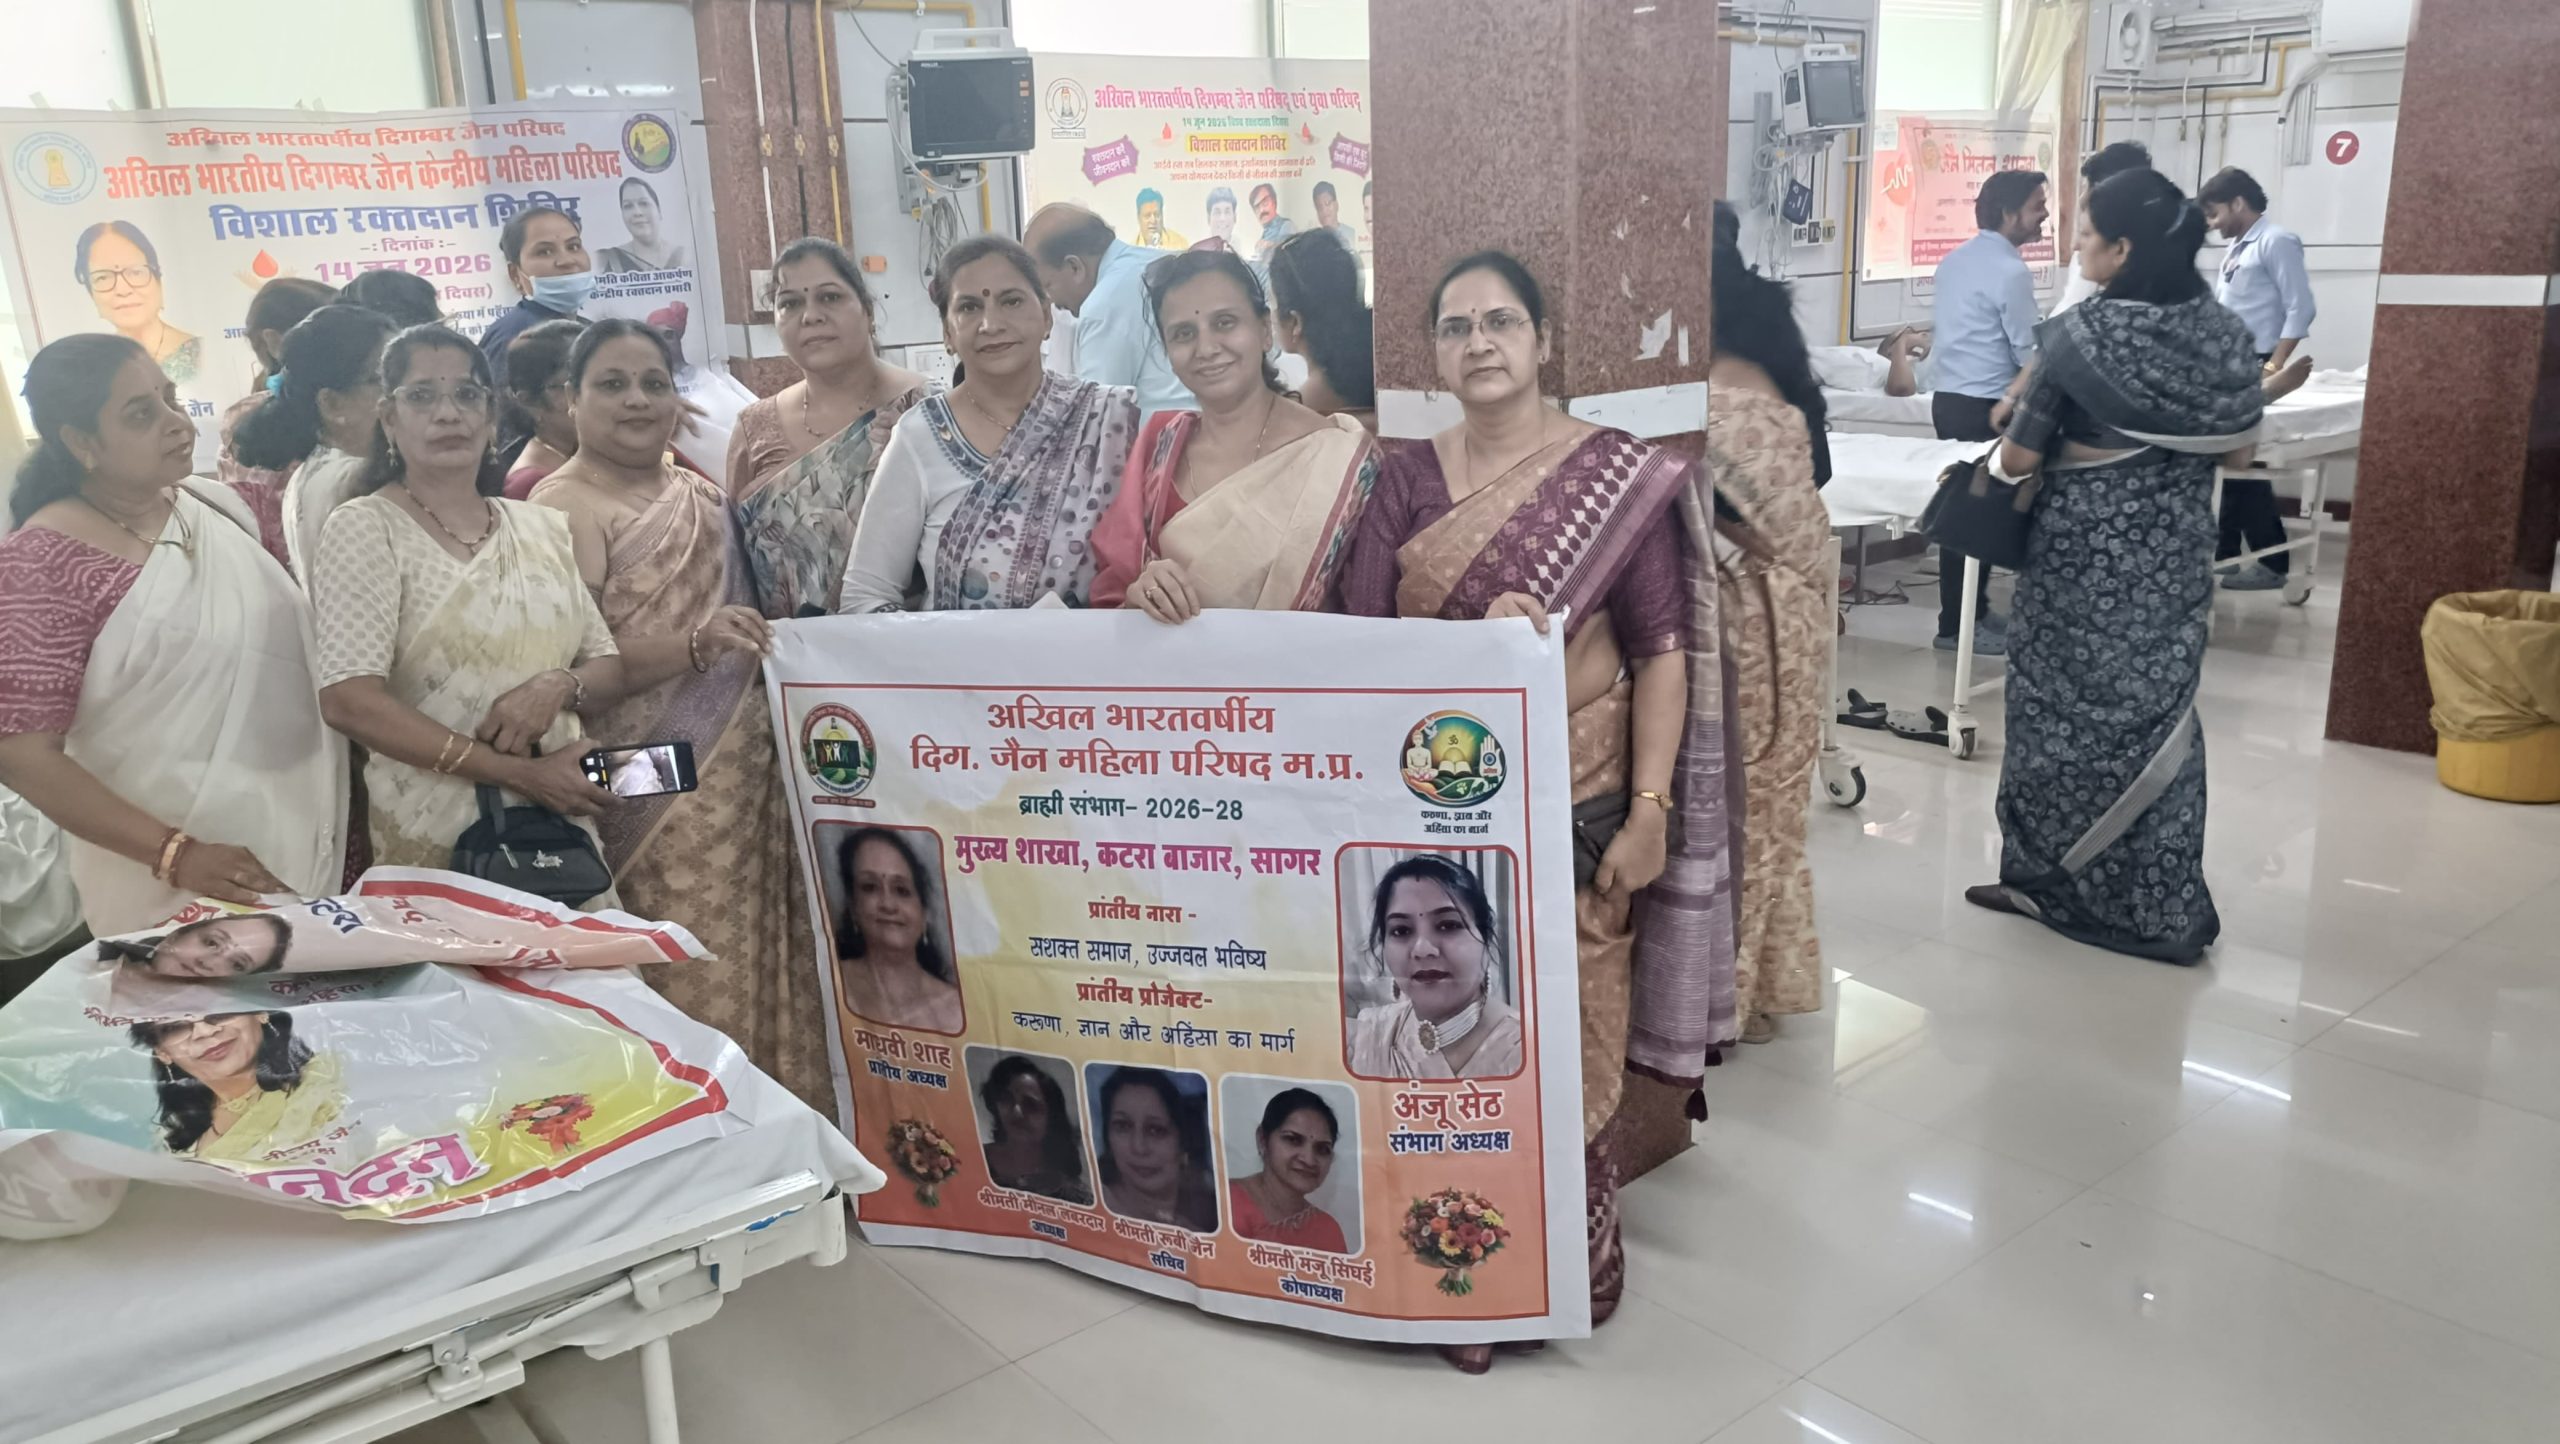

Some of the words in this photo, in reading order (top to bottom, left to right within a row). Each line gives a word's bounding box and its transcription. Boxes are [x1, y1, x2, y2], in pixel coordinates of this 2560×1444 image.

[1095, 85, 1136, 108] अखिल
[1138, 86, 1194, 109] भारतवर्षीय
[1195, 87, 1234, 109] दिगम्बर
[1235, 87, 1256, 109] जैन
[1258, 87, 1293, 113] परिषद्
[1291, 87, 1307, 109] एवं
[1308, 92, 1328, 115] युवा
[1329, 87, 1361, 113] परिषद्
[166, 127, 250, 147] अखिल
[256, 128, 372, 147] भारतवर्षीय
[375, 127, 455, 146] दिगम्बर
[460, 121, 498, 140] जैन
[503, 119, 566, 138] परिषद
[1189, 135, 1220, 153] विशाल
[1223, 137, 1258, 152] रक्तदान
[1260, 134, 1287, 152] शिविर
[2336, 138, 2352, 158] 7
[103, 156, 192, 199] अखिल
[196, 153, 286, 195] भारतीय
[286, 153, 369, 191] दिगम्बर
[371, 152, 414, 191] जैन
[493, 144, 560, 184] महिला
[562, 143, 623, 179] परिषद
[209, 204, 338, 240] विशाल
[343, 203, 480, 234] रक्तदान
[382, 237, 435, 252] दिनांक
[314, 262, 353, 282] 14
[414, 253, 492, 277] 2026
[620, 272, 650, 284] कविता
[653, 269, 692, 282] आकर्षण
[445, 282, 493, 300] दिवस)
[626, 285, 662, 297] रक्तदान
[665, 282, 692, 294] प्रभारी
[188, 399, 214, 416] जैन
[987, 693, 1095, 731] अखिल
[1106, 695, 1276, 733] भारतवर्षीय
[910, 734, 979, 773] दिग.
[990, 736, 1048, 772] जैन
[1057, 738, 1160, 778] महिला
[1170, 739, 1272, 781] परिषद
[1281, 753, 1364, 780] म.प्र.
[1018, 788, 1064, 818] ब्राह्मी
[1146, 797, 1243, 820] 2026-28
[1453, 825, 1466, 833] का
[954, 835, 1008, 874] मुख्य
[1015, 838, 1089, 873] शाखा,
[1096, 842, 1155, 870] कटरा
[1162, 844, 1242, 880] बाजार,
[1249, 847, 1321, 876] सागर
[1088, 895, 1141, 921] प्रांतीय
[1146, 904, 1182, 923] नारा
[1028, 936, 1080, 960] सशक्त
[1147, 943, 1208, 967] उज्जवल
[1215, 939, 1267, 970] भविष्य
[1076, 976, 1133, 1004] प्रांतीय
[1077, 1018, 1110, 1038] ज्ञान
[1119, 1016, 1152, 1042] और
[1161, 1020, 1217, 1048] अहिंसा
[1226, 1030, 1251, 1049] का
[1260, 1028, 1296, 1053] मार्ग
[854, 1030, 907, 1058] माधवी
[913, 1041, 952, 1069] शाह
[906, 1069, 948, 1089] अध्यक्ष
[1394, 1081, 1458, 1130] अंजू
[1457, 1081, 1502, 1119] सेठ
[1389, 1125, 1444, 1153] संभाग
[1451, 1131, 1510, 1151] अध्यक्ष
[248, 1133, 480, 1204] नंदन
[980, 1187, 1020, 1210] श्रीमती
[1031, 1220, 1066, 1239] अध्यक्ष
[1114, 1220, 1155, 1246] श्रीमती
[1190, 1234, 1215, 1258] जैन
[1150, 1251, 1185, 1272] सचिव
[1250, 1244, 1294, 1270] श्रीमती
[1299, 1251, 1332, 1281] मंजू
[1330, 1256, 1373, 1287] सिंघई
[1281, 1275, 1344, 1302] कोषाध्यक्ष
